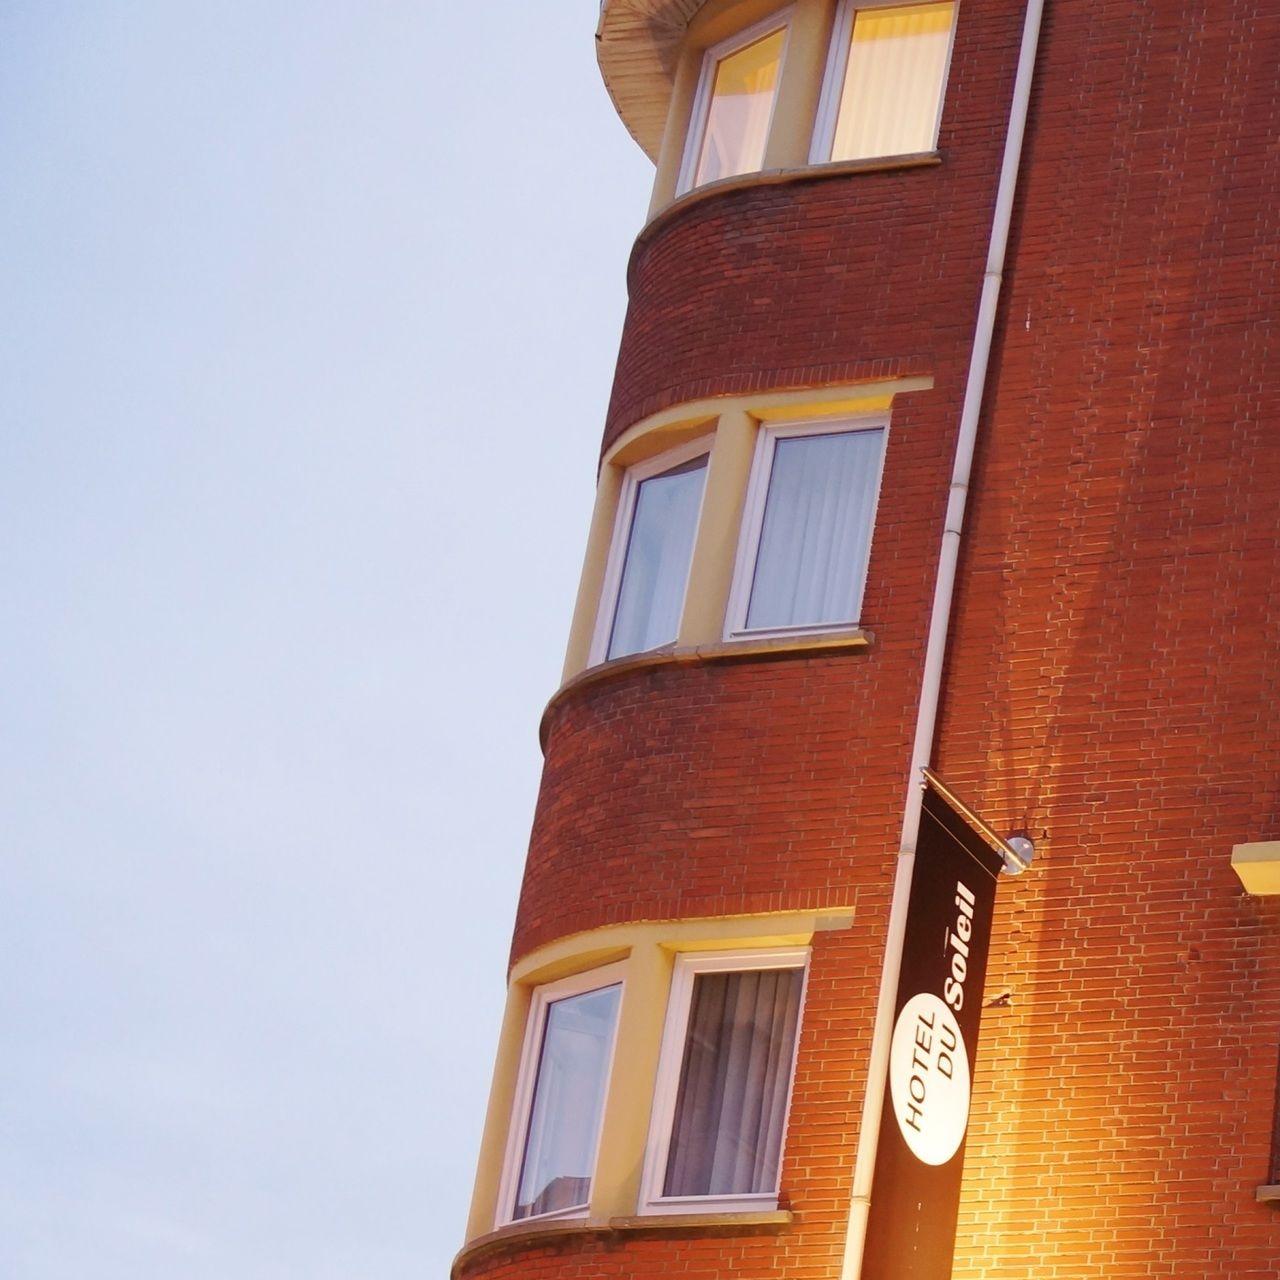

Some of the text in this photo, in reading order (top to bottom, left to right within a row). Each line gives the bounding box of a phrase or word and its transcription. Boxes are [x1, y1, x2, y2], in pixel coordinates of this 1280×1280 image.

[937, 881, 976, 1080] DU Soleil
[904, 1012, 935, 1132] HOTEL
